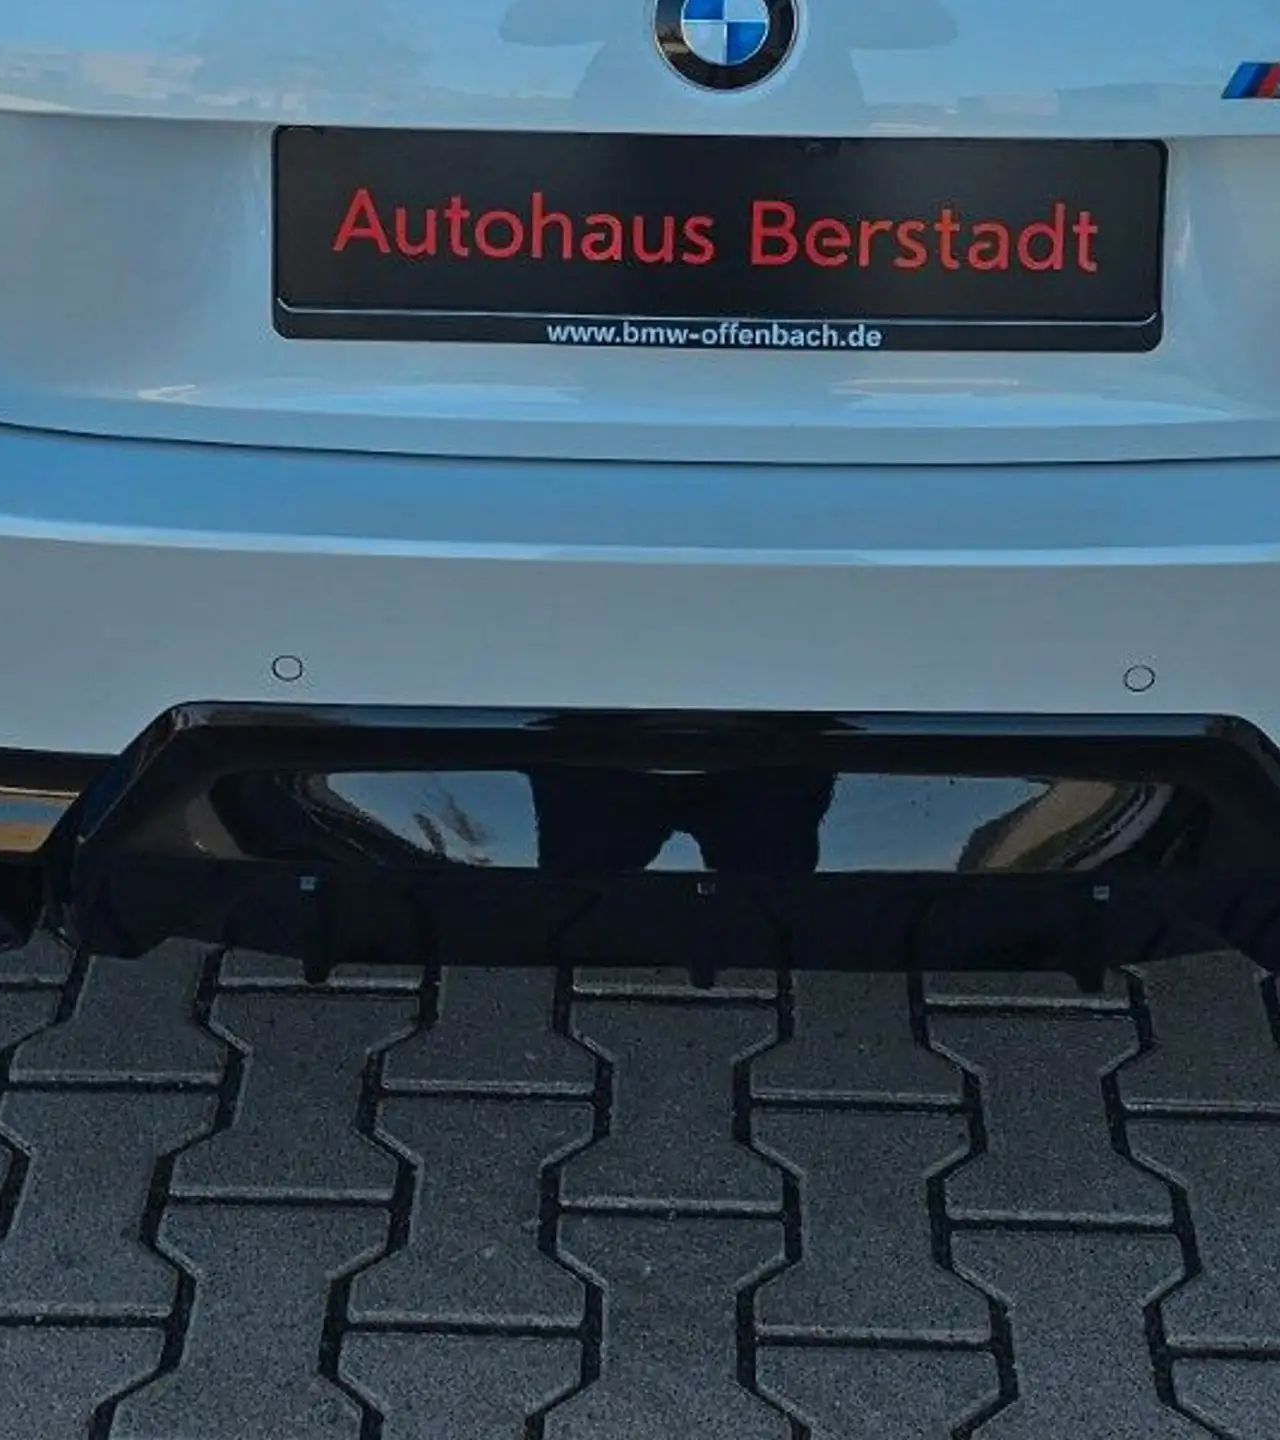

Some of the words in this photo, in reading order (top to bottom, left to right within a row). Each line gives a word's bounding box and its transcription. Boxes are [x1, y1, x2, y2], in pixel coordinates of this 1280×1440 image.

[332, 187, 717, 265] Autohaus
[750, 199, 1100, 273] Berstadt
[546, 321, 883, 348] www.bmw-offenbach.de
